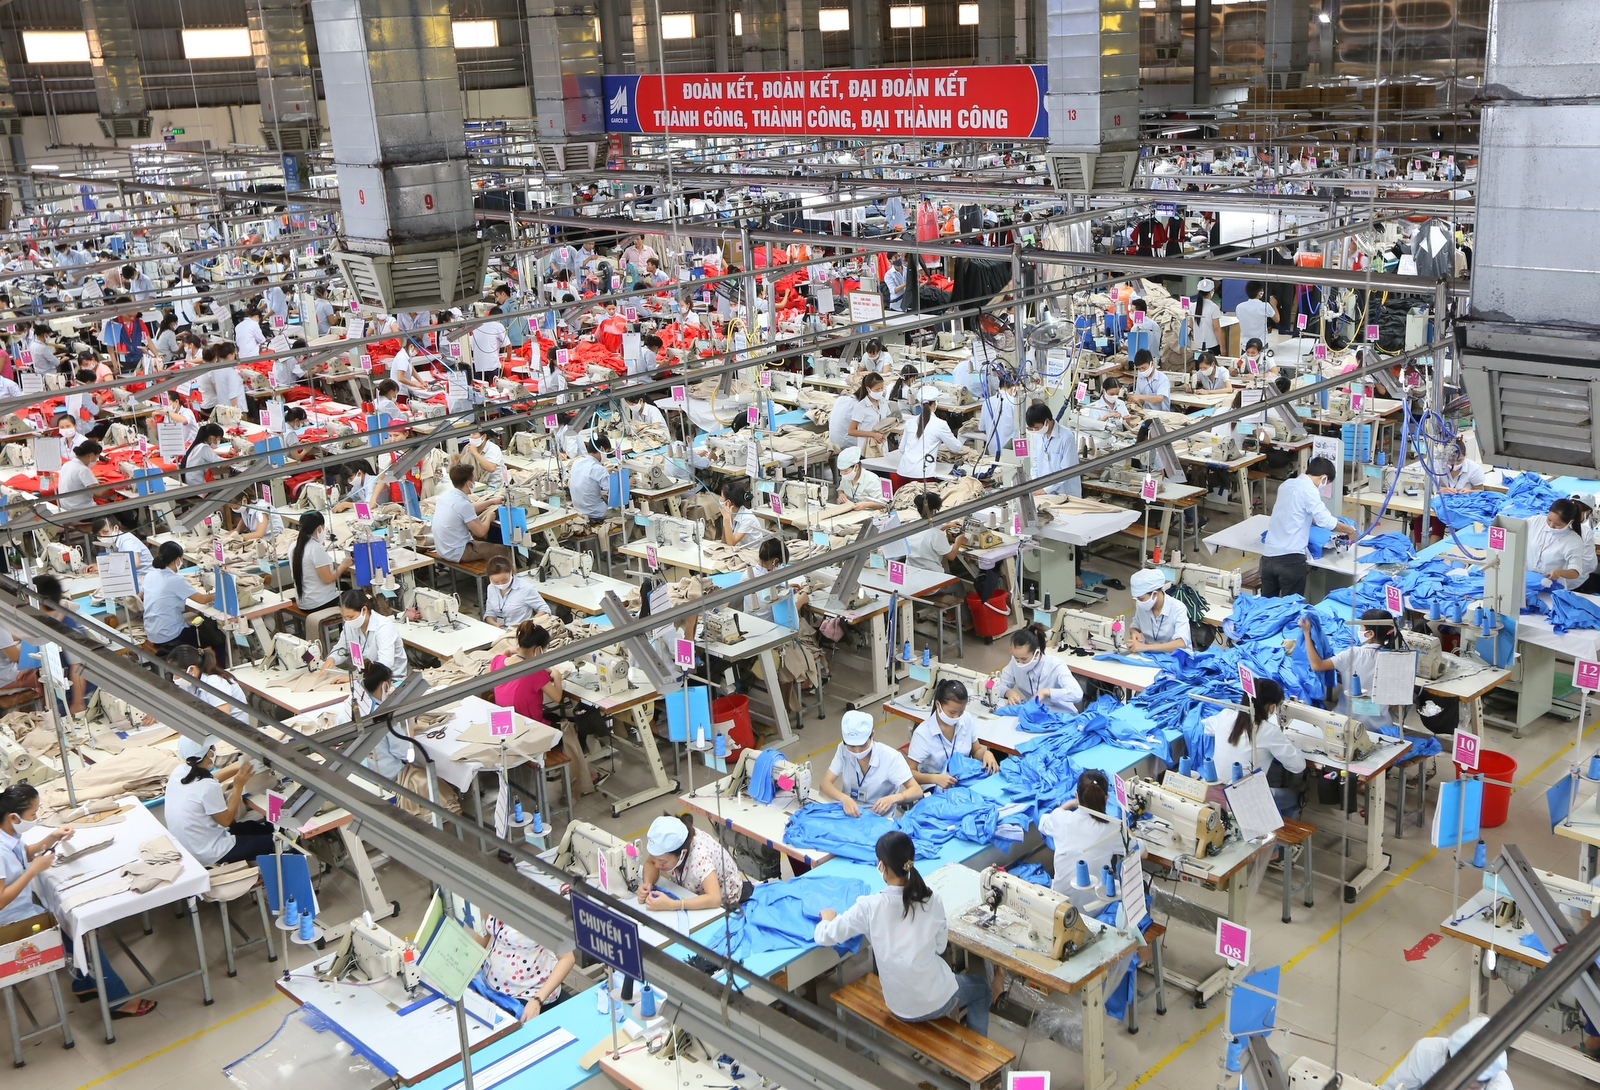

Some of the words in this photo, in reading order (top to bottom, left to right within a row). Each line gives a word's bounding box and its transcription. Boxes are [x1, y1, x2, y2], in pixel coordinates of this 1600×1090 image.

[682, 78, 723, 99] ĐOÀN
[727, 75, 759, 101] KẾT,
[762, 76, 805, 99] ĐOÀN
[810, 73, 844, 100] KẾT,
[848, 78, 876, 102] ĐẠI
[881, 72, 929, 98] ĐOÀN
[935, 69, 967, 97] KẾT
[581, 114, 587, 123] 5
[653, 106, 699, 127] THÀNH
[703, 106, 748, 130] CÔNG,
[752, 105, 803, 128] THÀNH
[807, 105, 857, 130] CÔNG,
[861, 109, 890, 132] ĐẠI
[894, 104, 952, 129] THÀNH
[957, 104, 1008, 129] CÔNG
[1067, 109, 1077, 121] 13
[1113, 115, 1121, 126] 13
[549, 119, 554, 129] 5
[358, 189, 365, 205] 9
[424, 194, 434, 210] 9
[1491, 529, 1504, 539] 34
[891, 563, 902, 572] 21
[1388, 589, 1398, 599] 32
[680, 654, 690, 664] 19
[1581, 664, 1598, 676] 12
[496, 725, 510, 734] 17
[1459, 737, 1475, 751] 10
[1573, 896, 1593, 904] JUKI
[624, 933, 632, 950] 1
[589, 933, 615, 961] LINE
[617, 948, 624, 965] 1
[1223, 944, 1242, 959] 08
